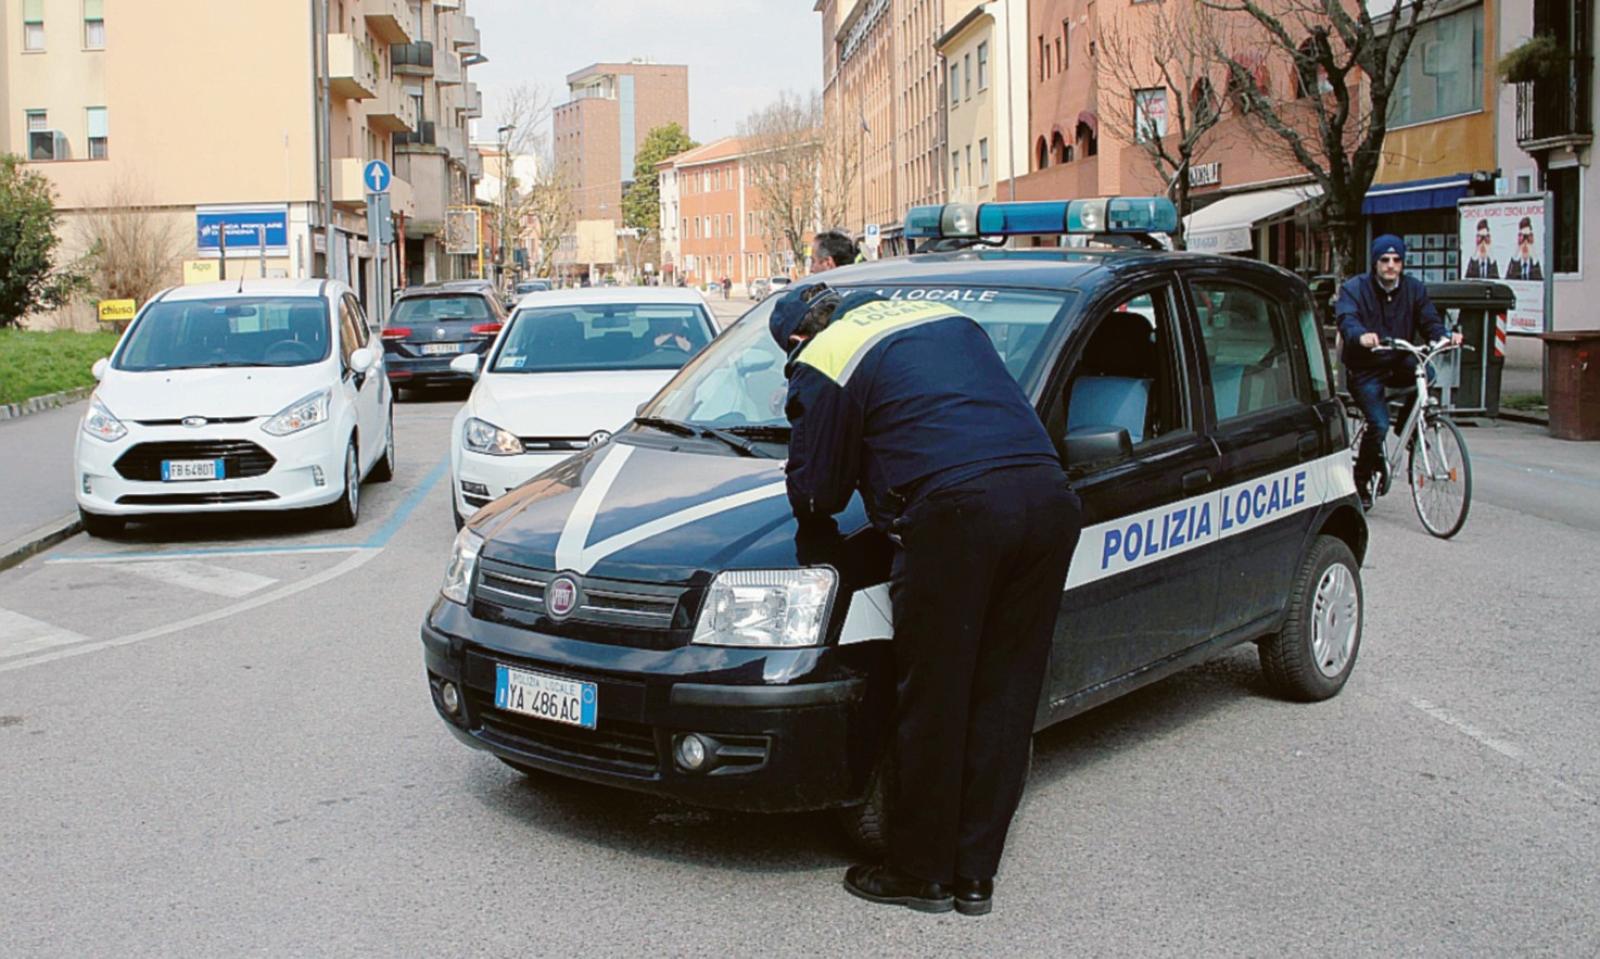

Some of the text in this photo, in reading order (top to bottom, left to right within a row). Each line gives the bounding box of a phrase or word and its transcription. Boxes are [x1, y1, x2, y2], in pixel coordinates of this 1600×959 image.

[889, 289, 999, 302] LOCALE
[101, 304, 133, 315] chiuso
[1101, 471, 1306, 570] POLIZIA LOCALE
[512, 672, 576, 696] POLIZIA LOCALE
[510, 684, 524, 710] YA
